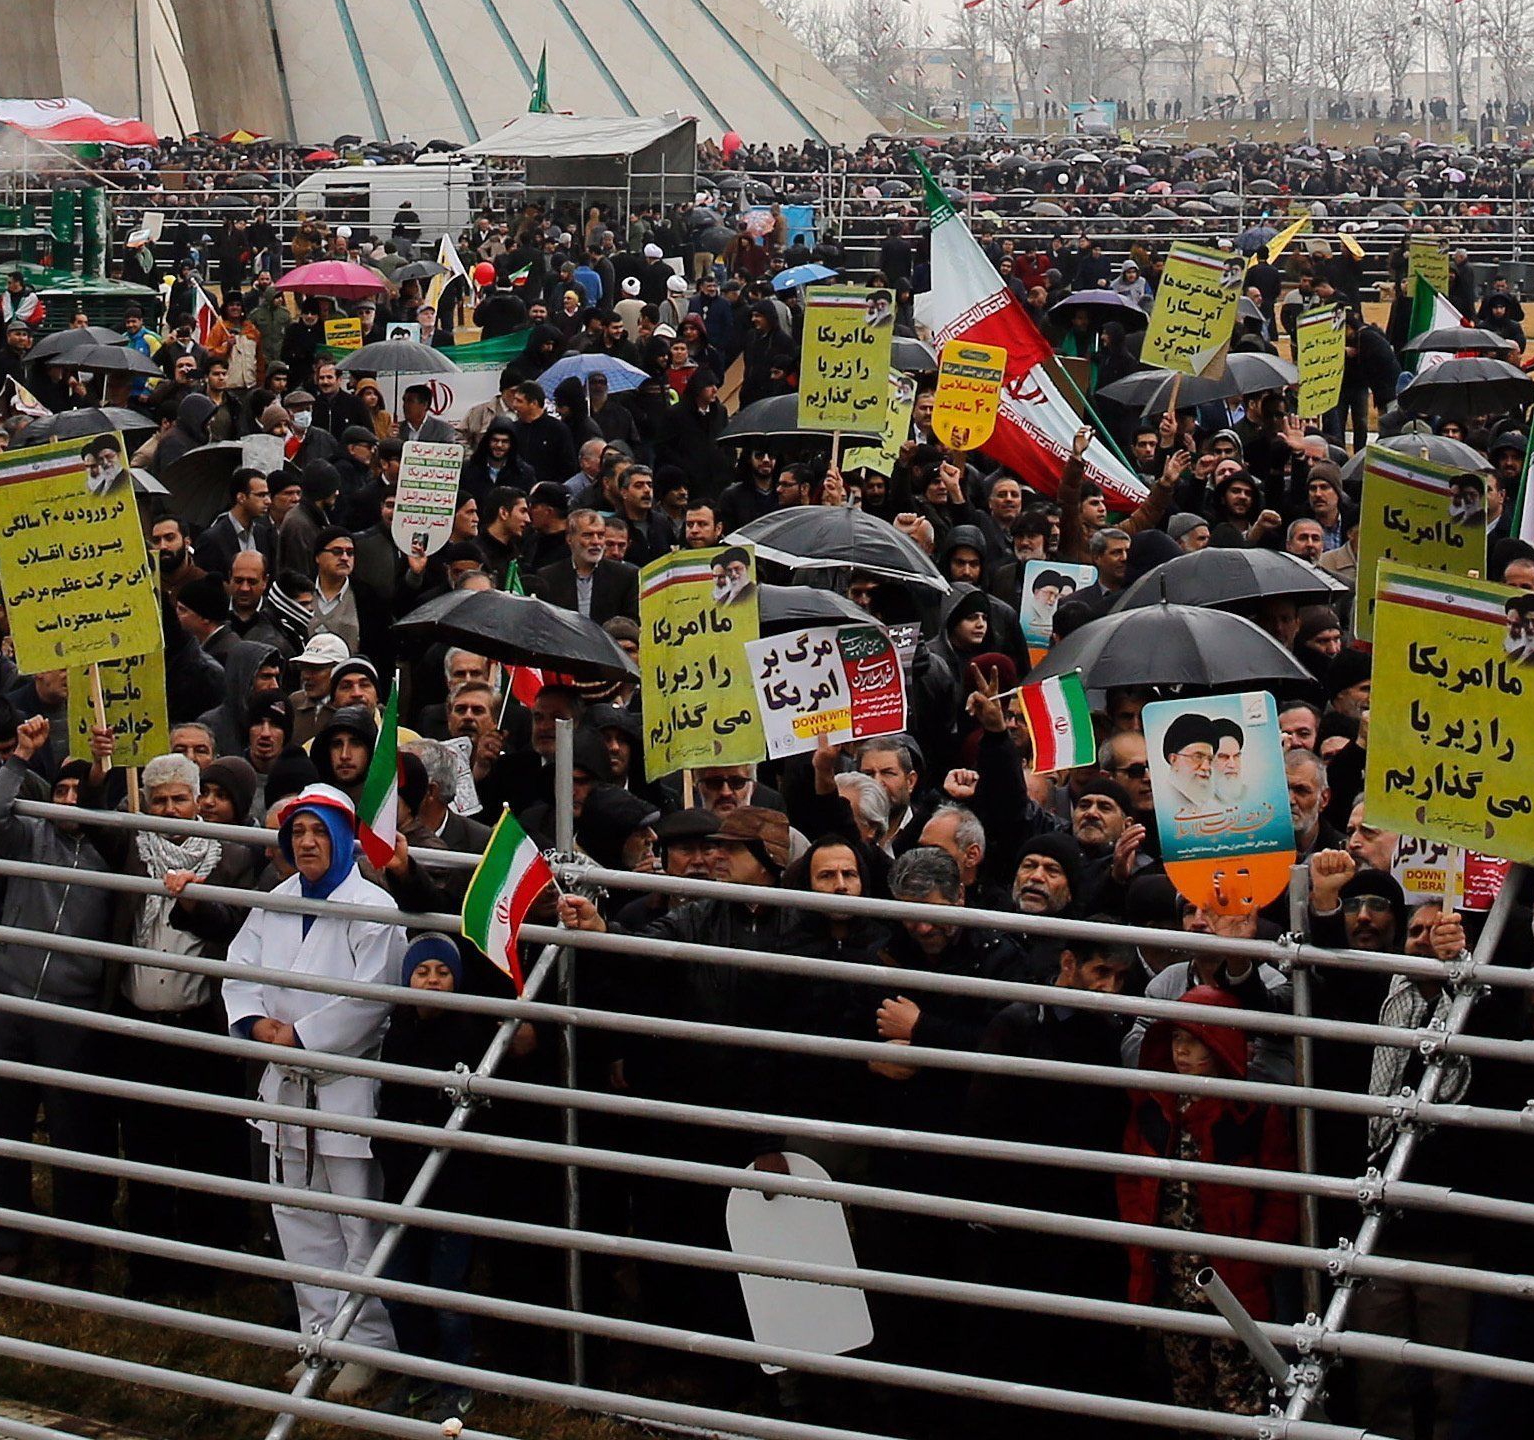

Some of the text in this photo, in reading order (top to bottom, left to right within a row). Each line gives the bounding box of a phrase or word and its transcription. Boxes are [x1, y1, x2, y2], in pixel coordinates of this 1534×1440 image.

[1175, 280, 1202, 296] عرصه
[1203, 285, 1223, 299] همه
[1222, 291, 1237, 305] در
[1167, 296, 1223, 321] آمریکا را
[817, 325, 875, 348] ما امریکا
[1154, 336, 1177, 352] کرد
[817, 356, 869, 380] را زیر پا
[806, 386, 878, 410] می گذاریم
[975, 399, 991, 414] ۴۰
[1, 500, 126, 538] در ورود به ۴۰ سالگی
[1383, 504, 1464, 548] ما امریکا
[17, 538, 125, 566] پیروزی انقلاب
[8, 562, 148, 607] این حرکت عظیم مردمی
[36, 602, 132, 633] شبیه معجزه است
[652, 607, 733, 647] ما امریکا
[759, 648, 781, 680] بر
[784, 632, 833, 668] مرگ
[655, 655, 732, 698] را زیر پا
[1408, 641, 1523, 696] ما امریکا
[763, 668, 840, 713] امریکا
[650, 702, 752, 749] می گذاریم
[791, 708, 851, 730] DOWN WITH
[1410, 698, 1515, 763] را زیر پا
[1384, 761, 1532, 819] می گذاریم
[1406, 869, 1441, 880] DOWN
